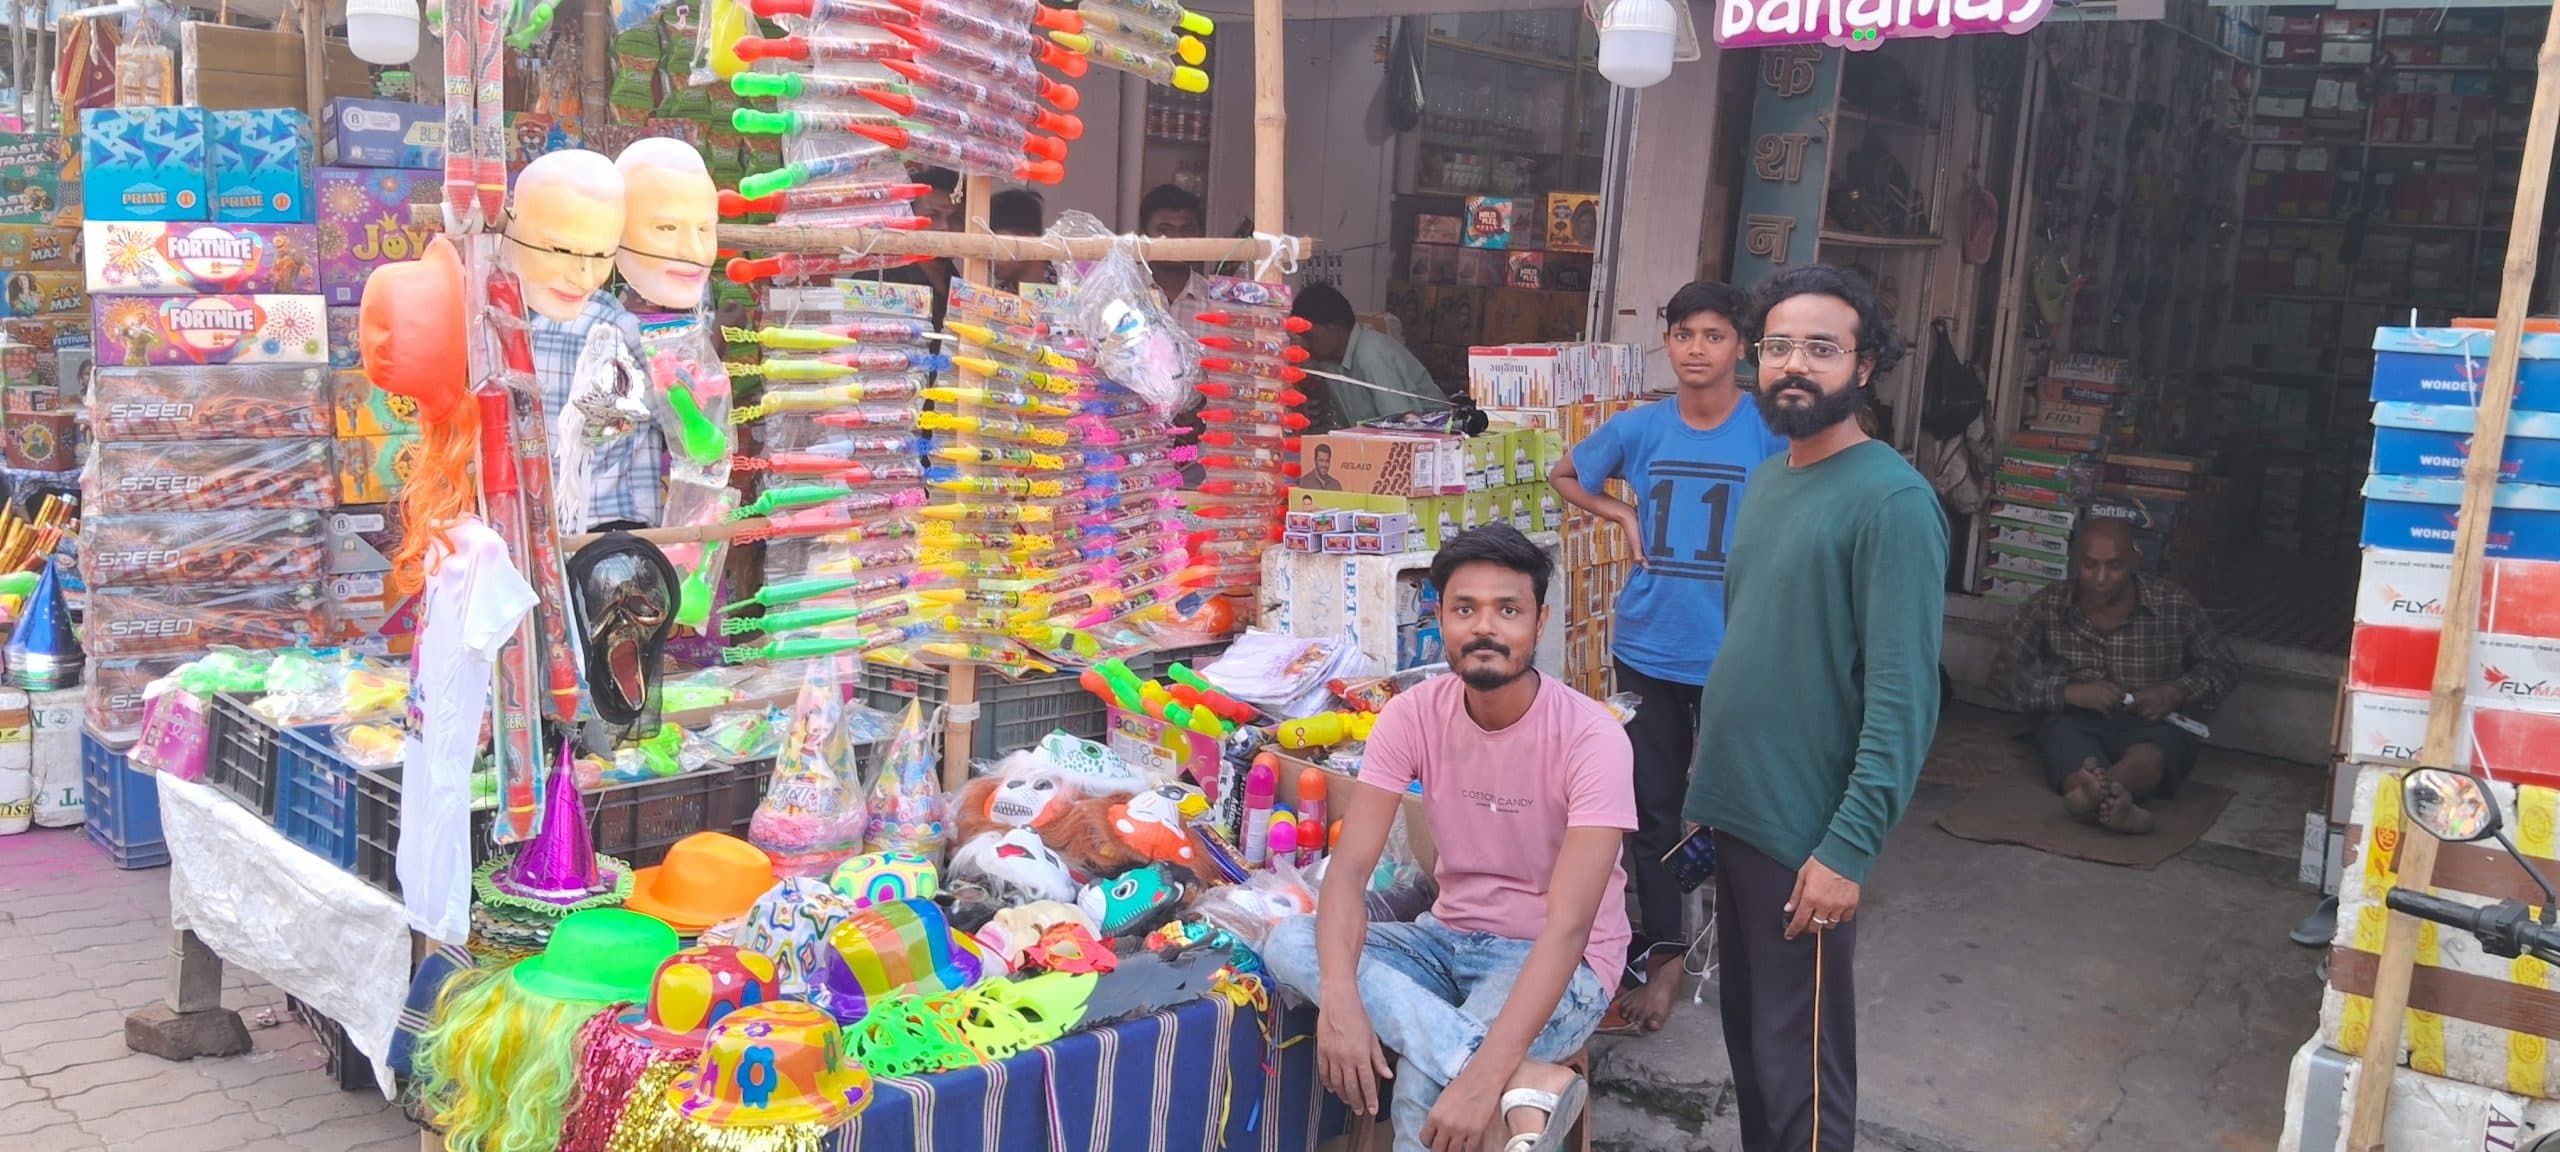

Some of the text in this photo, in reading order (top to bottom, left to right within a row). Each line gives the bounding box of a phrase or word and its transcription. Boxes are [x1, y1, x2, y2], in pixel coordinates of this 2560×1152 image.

[1747, 44, 1822, 263] फशन
[122, 192, 168, 205] PRIME
[32, 235, 58, 248] SKY
[167, 236, 254, 259] FORTNITE
[31, 247, 61, 262] MAX
[52, 285, 79, 299] SKY
[50, 297, 81, 312] MAX
[168, 307, 256, 331] FORTNITE
[111, 403, 194, 420] SPEED
[2420, 455, 2467, 468] WONDE
[120, 474, 203, 493] SPEED
[1648, 479, 1730, 563] 11
[2410, 527, 2457, 540] WONDE
[98, 550, 180, 568] SPEED
[111, 618, 193, 637] SPEED
[1461, 789, 1534, 807] COTTON CANDY
